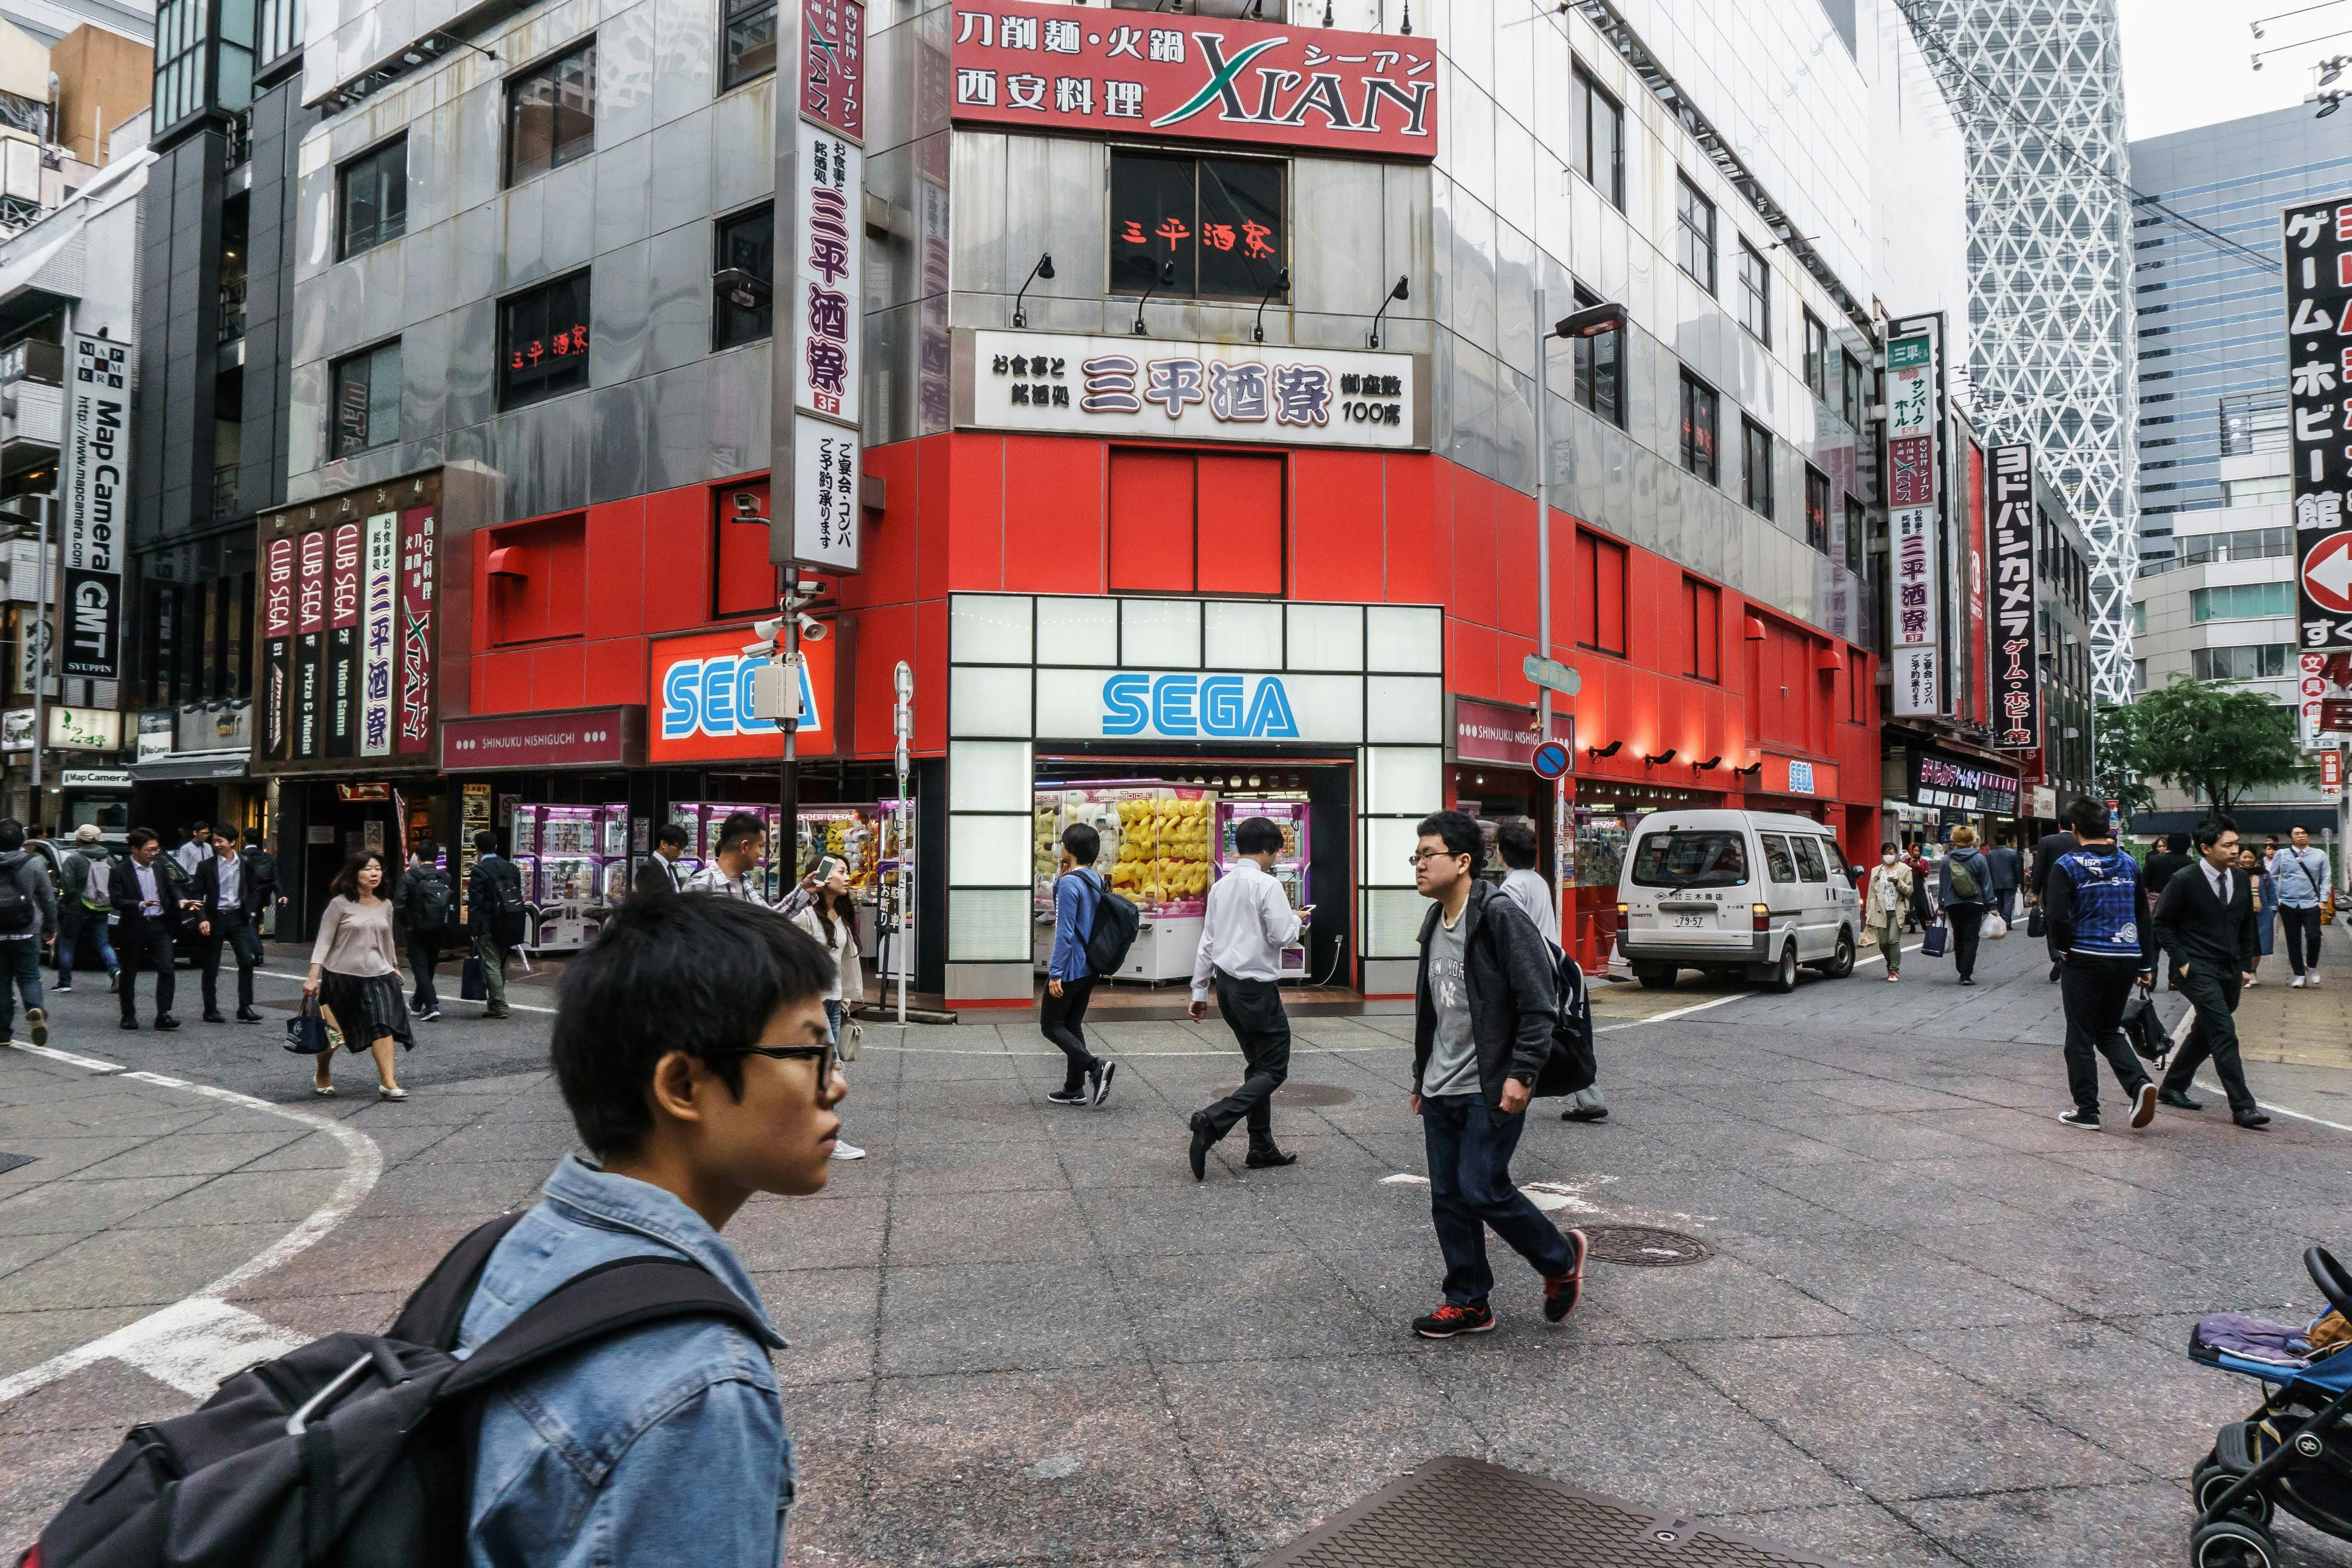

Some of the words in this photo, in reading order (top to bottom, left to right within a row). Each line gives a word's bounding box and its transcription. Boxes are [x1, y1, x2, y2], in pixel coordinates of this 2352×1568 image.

[956, 11, 1185, 63] 刀削麺・火鍋
[1303, 43, 1433, 76] シーアン
[843, 64, 858, 128] シーアン
[957, 67, 1145, 119] 西安料理
[833, 141, 846, 192] お食事と
[806, 187, 848, 397] 三平酒寮
[992, 354, 1065, 378] お食事と
[2286, 211, 2342, 530] ゲーム・ホビー館
[817, 395, 836, 412] 3F
[1011, 382, 1070, 406] 銘酒処
[1080, 354, 1333, 426] 三平酒寮
[1342, 400, 1401, 425] 100席
[1911, 379, 1927, 424] サンパーク
[89, 400, 122, 460] Map
[1895, 400, 1909, 427] ホール
[72, 396, 90, 567] http://www.mapcamera.com
[377, 489, 387, 503] 3F
[414, 479, 424, 493] 4F
[819, 438, 834, 549] ご予約承ります
[838, 443, 852, 548] ご宴会・コンパ
[1919, 469, 1929, 500] シーアン
[91, 465, 120, 571] Camera
[342, 498, 350, 511] 2F
[270, 539, 291, 583] CLUB
[303, 532, 324, 577] CLUB
[336, 524, 358, 570] CLUB
[1996, 446, 2030, 636] ヨドバシカメラ
[301, 580, 321, 626] SEGA
[334, 573, 356, 620] SEGA
[1900, 534, 1927, 633] 三平酒寮
[75, 581, 109, 658] GMT
[269, 586, 289, 631] SEGA
[273, 642, 282, 656] B1
[305, 634, 315, 647] 1F
[339, 629, 349, 644] 2F
[68, 663, 111, 673] SYUPPIN
[337, 659, 349, 696] Video
[366, 572, 391, 749] 三平酒寮
[421, 672, 430, 739] シーアン
[1102, 673, 1299, 737] SEGA
[2003, 639, 2031, 744] ゲーム・ホビー館
[337, 699, 347, 736] Game
[1478, 725, 1513, 742] SHINJUKU
[482, 736, 522, 749] SHINJUKU
[524, 733, 574, 746] NISHIGUCHI
[70, 773, 86, 782] Map
[87, 774, 128, 782] Camera
[1120, 791, 1152, 800] TRIPLE
[1789, 760, 1814, 794] SEGA
[880, 884, 890, 926] お断り
[1680, 917, 1703, 926] 79-57
